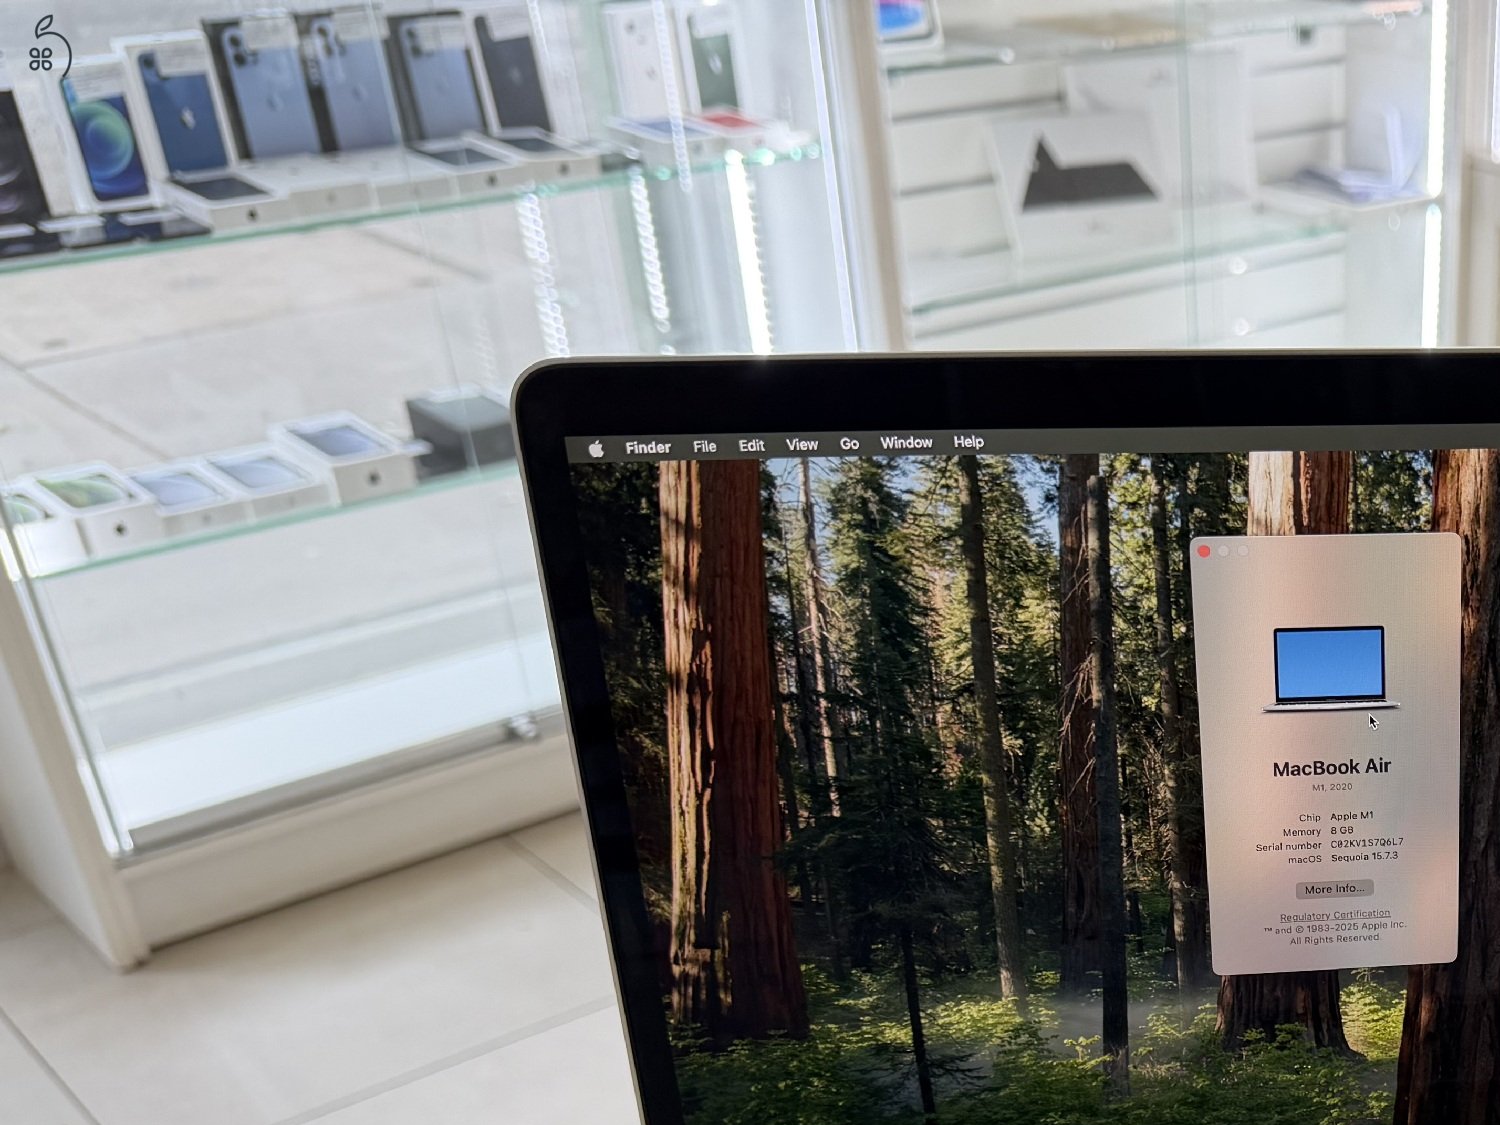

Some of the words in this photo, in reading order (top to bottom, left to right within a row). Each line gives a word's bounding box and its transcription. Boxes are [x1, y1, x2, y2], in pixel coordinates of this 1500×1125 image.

[625, 439, 672, 455] Finder
[692, 439, 717, 454] File
[738, 438, 765, 453] Edit
[786, 438, 819, 452] View
[840, 438, 859, 451] Go
[880, 435, 933, 451] Window
[953, 434, 985, 452] Help
[1273, 758, 1360, 777] MacBook
[1365, 757, 1392, 773] Air
[1329, 783, 1353, 791] 2020
[1299, 813, 1321, 823] Chip
[1330, 811, 1358, 822] Apple
[1360, 811, 1374, 820] M1
[1283, 827, 1322, 838] Memory
[1330, 827, 1337, 835] 8
[1339, 826, 1354, 835] GB
[1256, 842, 1283, 852] Serial
[1285, 841, 1322, 851] number
[1288, 855, 1322, 864] macOS
[1331, 852, 1369, 863] Sequoia
[1372, 851, 1399, 860] 15.7.3
[1305, 884, 1333, 895] More
[1280, 912, 1331, 923] Regulatory
[1333, 909, 1391, 920] Certification
[1275, 926, 1292, 935] and
[1361, 921, 1389, 932] Apple
[1390, 920, 1407, 929] Inc.
[1290, 937, 1301, 945] All
[1304, 935, 1334, 946] Rights
